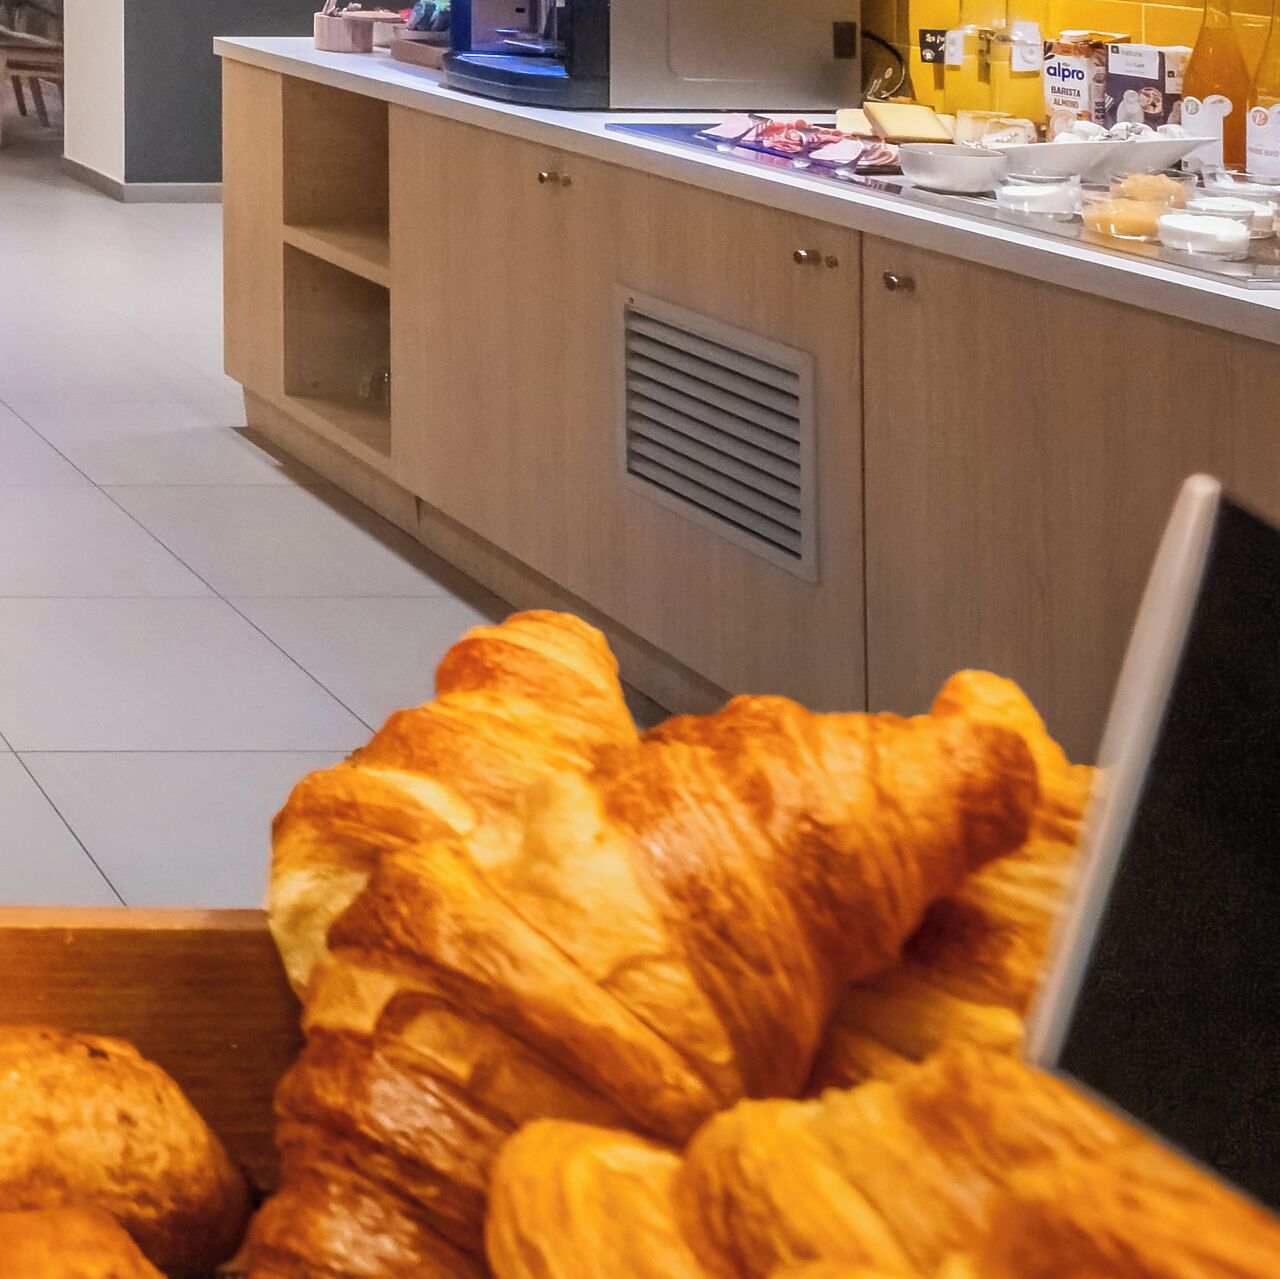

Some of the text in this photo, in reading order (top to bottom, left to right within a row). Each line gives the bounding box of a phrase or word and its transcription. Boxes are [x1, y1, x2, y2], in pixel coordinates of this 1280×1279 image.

[1046, 62, 1085, 82] alpro
[1051, 86, 1081, 98] BARISTA
[1053, 98, 1080, 109] ALMOND
